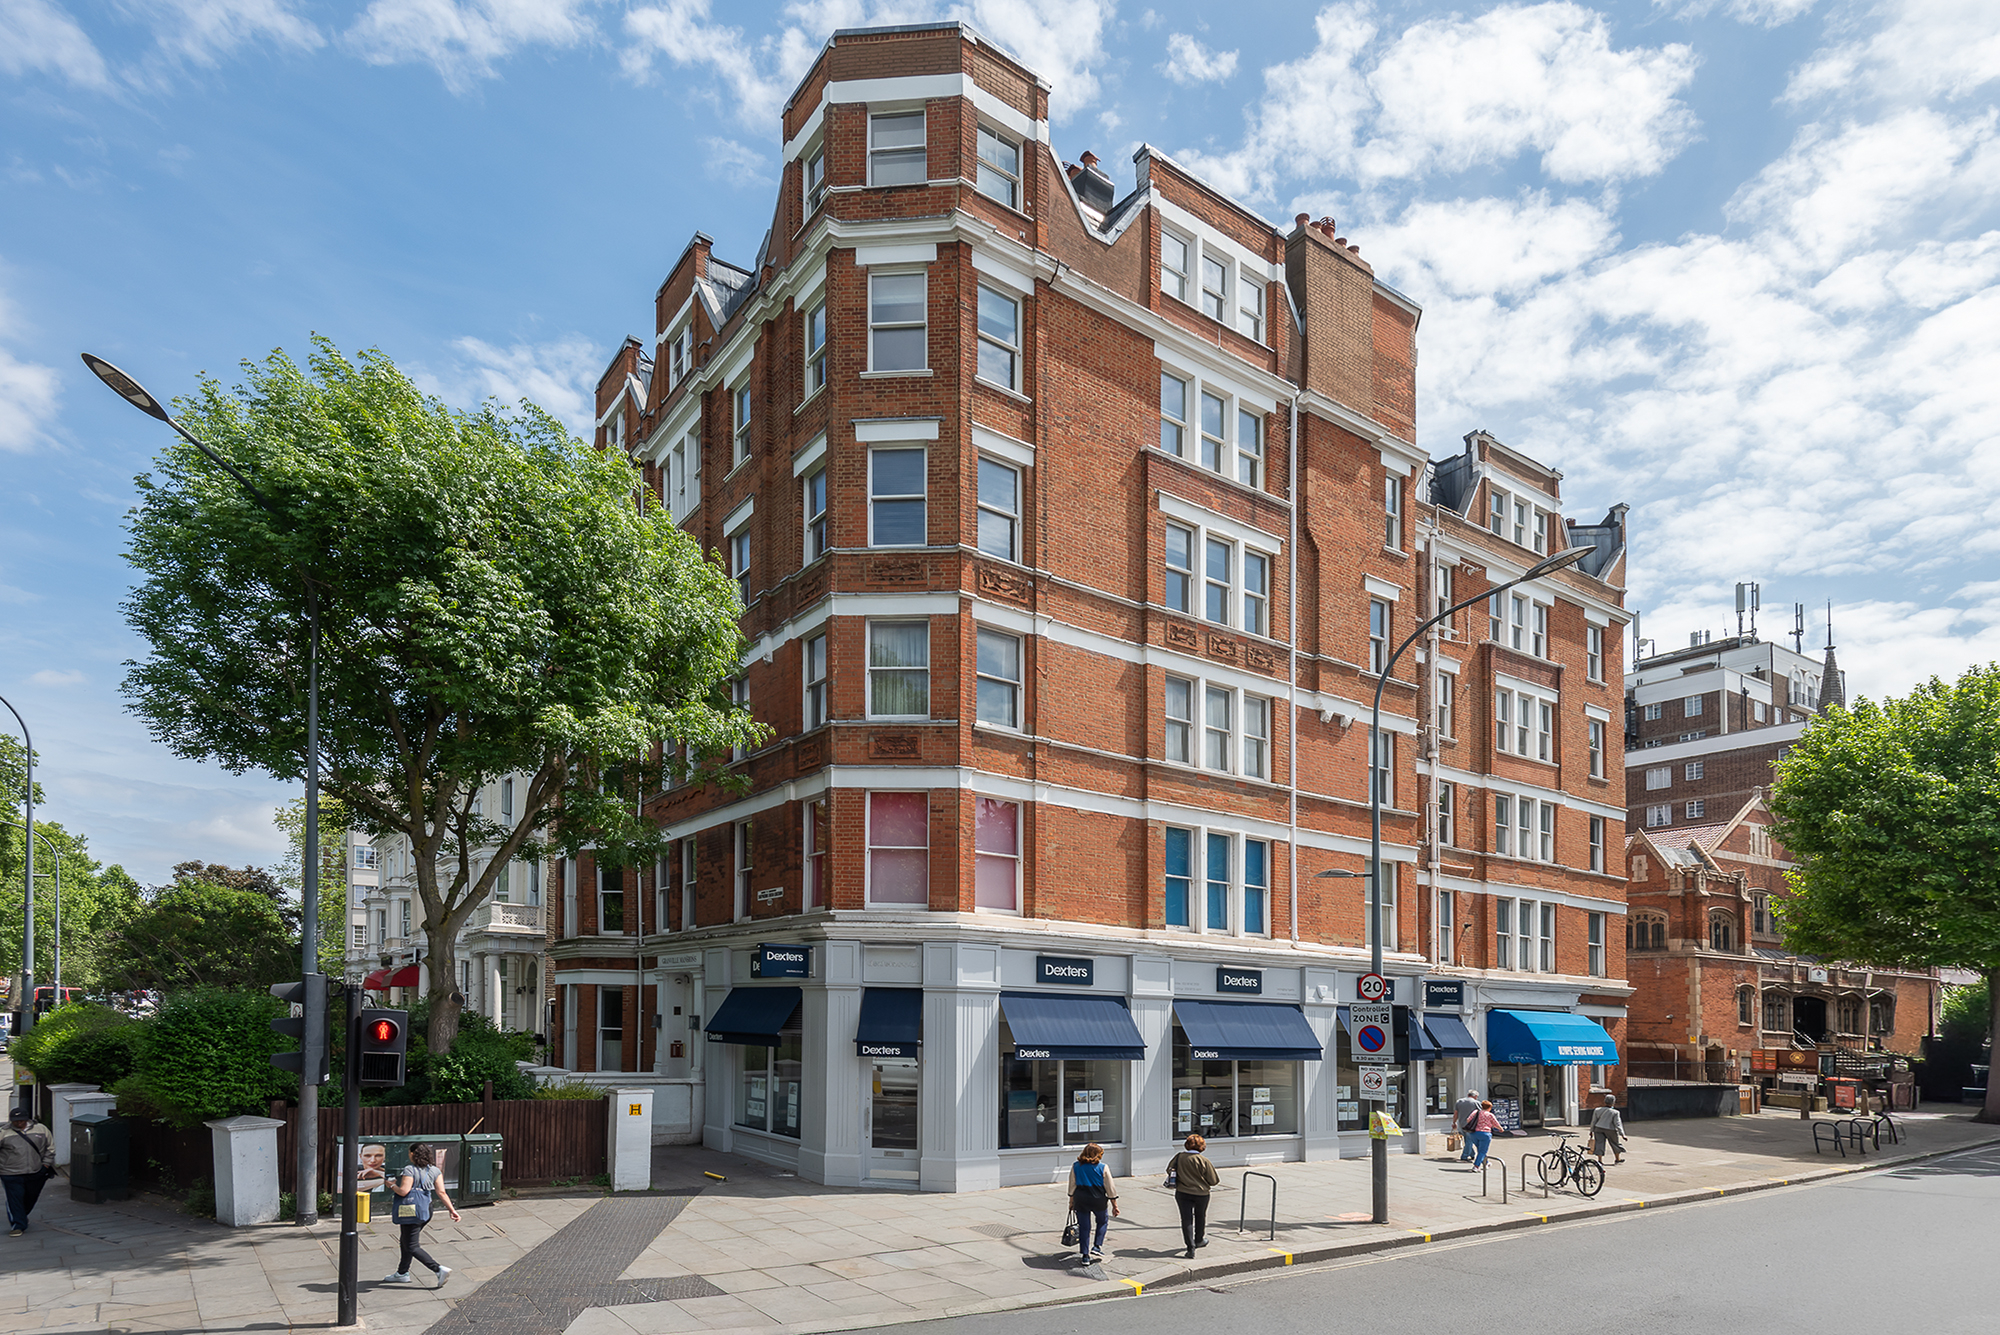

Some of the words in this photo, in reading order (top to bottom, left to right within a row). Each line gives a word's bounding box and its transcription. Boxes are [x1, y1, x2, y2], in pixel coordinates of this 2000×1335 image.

[767, 951, 804, 962] Dexters
[1045, 963, 1088, 978] Dexters
[1223, 975, 1258, 987] Dexters
[1362, 981, 1382, 993] 20
[1429, 985, 1458, 993] Dexters
[1381, 1014, 1389, 1023] C
[862, 1045, 901, 1055] Dexters
[1019, 1049, 1050, 1058] Dexters
[1194, 1050, 1219, 1058] Dexters
[630, 1104, 641, 1115] H
